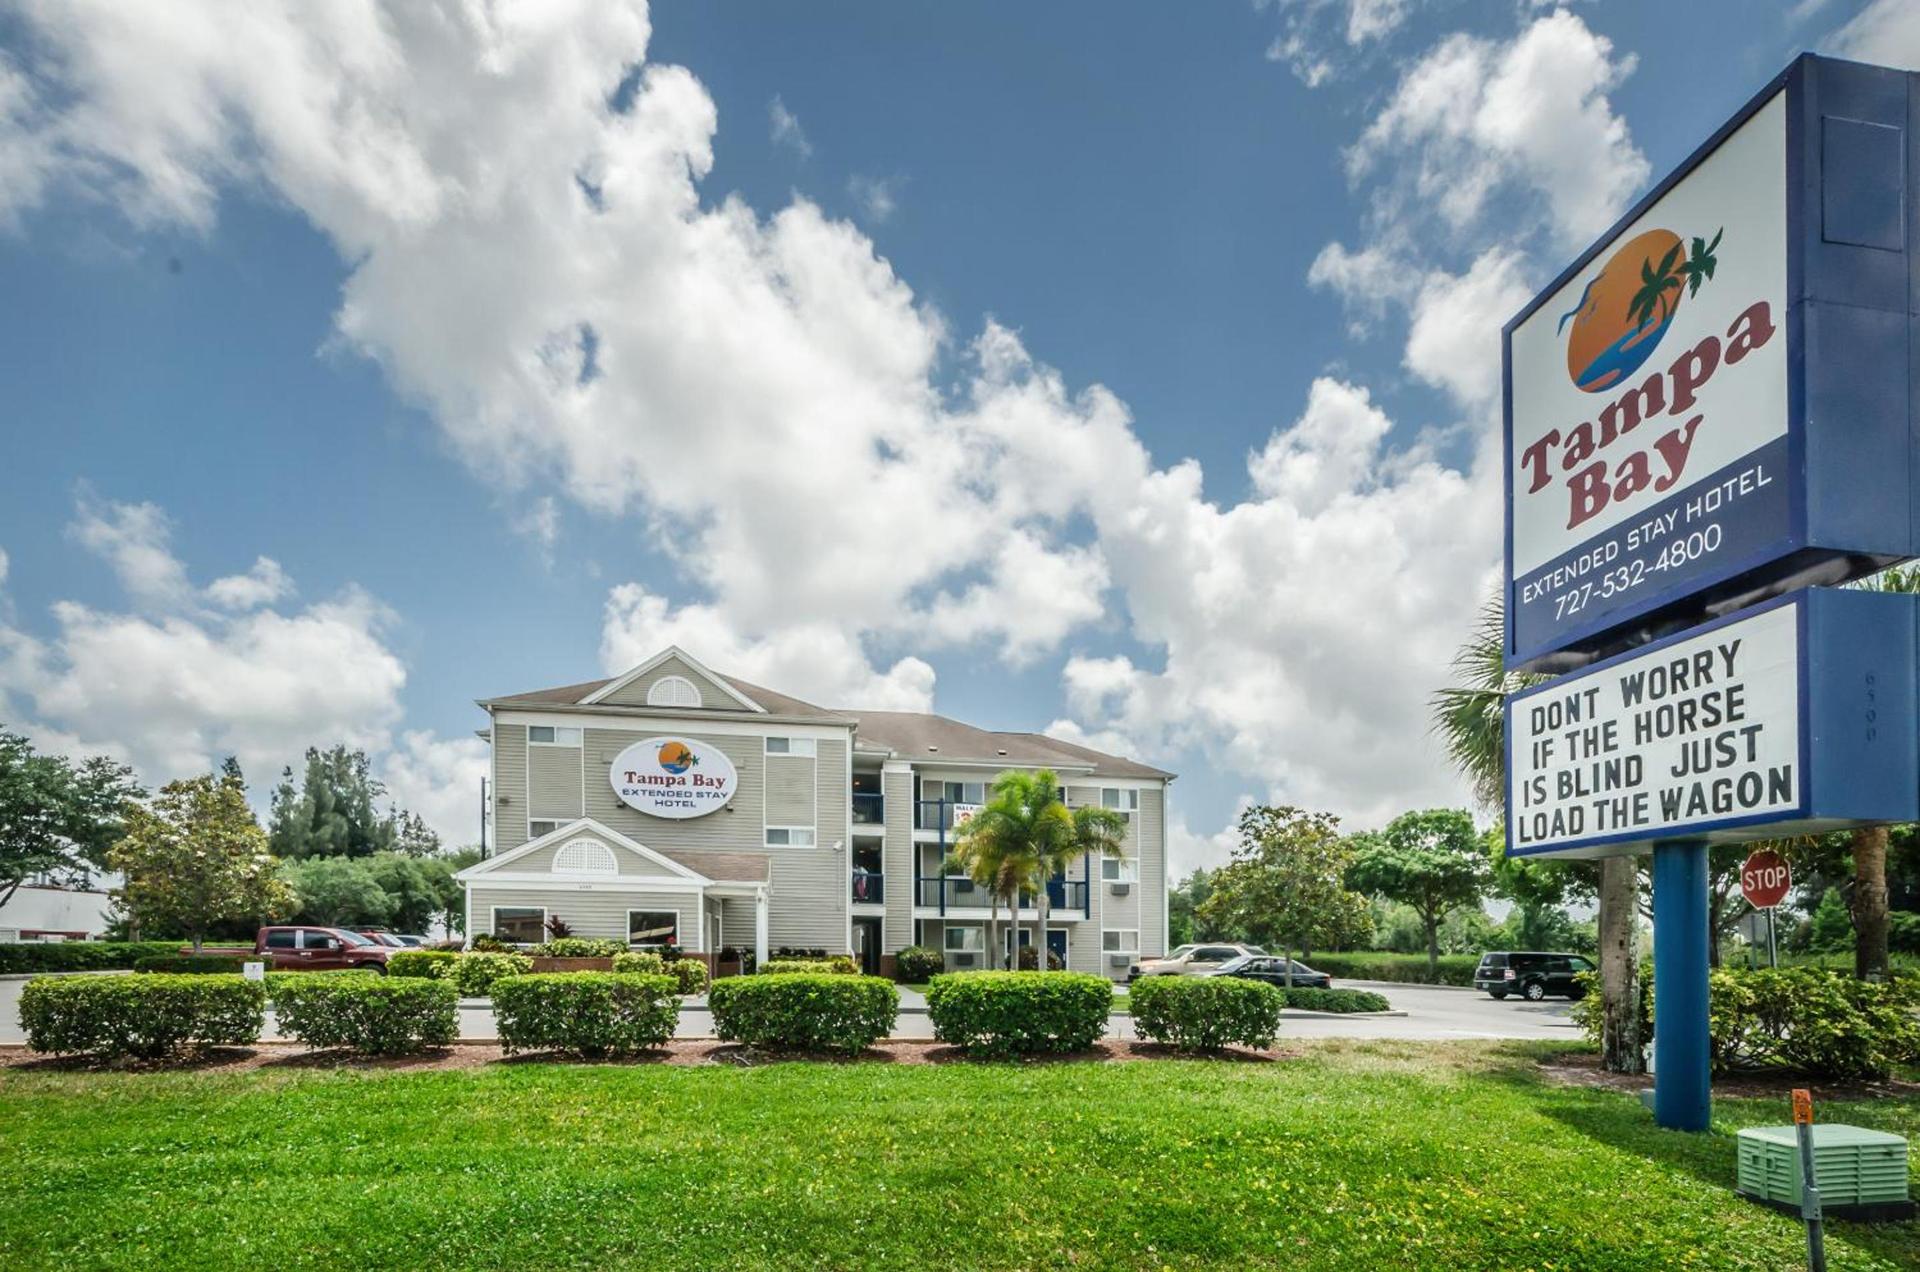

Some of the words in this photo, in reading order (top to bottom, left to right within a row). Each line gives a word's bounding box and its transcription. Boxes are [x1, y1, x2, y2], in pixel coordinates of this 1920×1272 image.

[1521, 300, 1776, 494] Tampa
[1566, 414, 1704, 530] Bay
[1523, 540, 1618, 604] EXTENDED
[1627, 508, 1679, 550] STAY
[1686, 465, 1772, 523] HOTEL
[1555, 524, 1722, 621] 727-532-4800
[1531, 687, 1600, 736] DONT
[1620, 639, 1741, 708] WORRY
[1533, 739, 1554, 770] IF
[1565, 720, 1619, 761] THE
[1634, 683, 1745, 745] HORSE
[622, 789, 692, 798] EXTENDED
[696, 791, 728, 799] STAY
[624, 772, 686, 787] Tampa
[693, 774, 726, 789] Bay
[655, 800, 697, 808] HOTEL
[1519, 805, 1584, 843] LOAD
[1593, 792, 1649, 831] THE
[1659, 764, 1792, 822] WAGON
[1524, 776, 1547, 808] IS
[1557, 755, 1643, 801] BLIND
[1671, 724, 1763, 778] JUST
[1745, 866, 1786, 891] STOP
